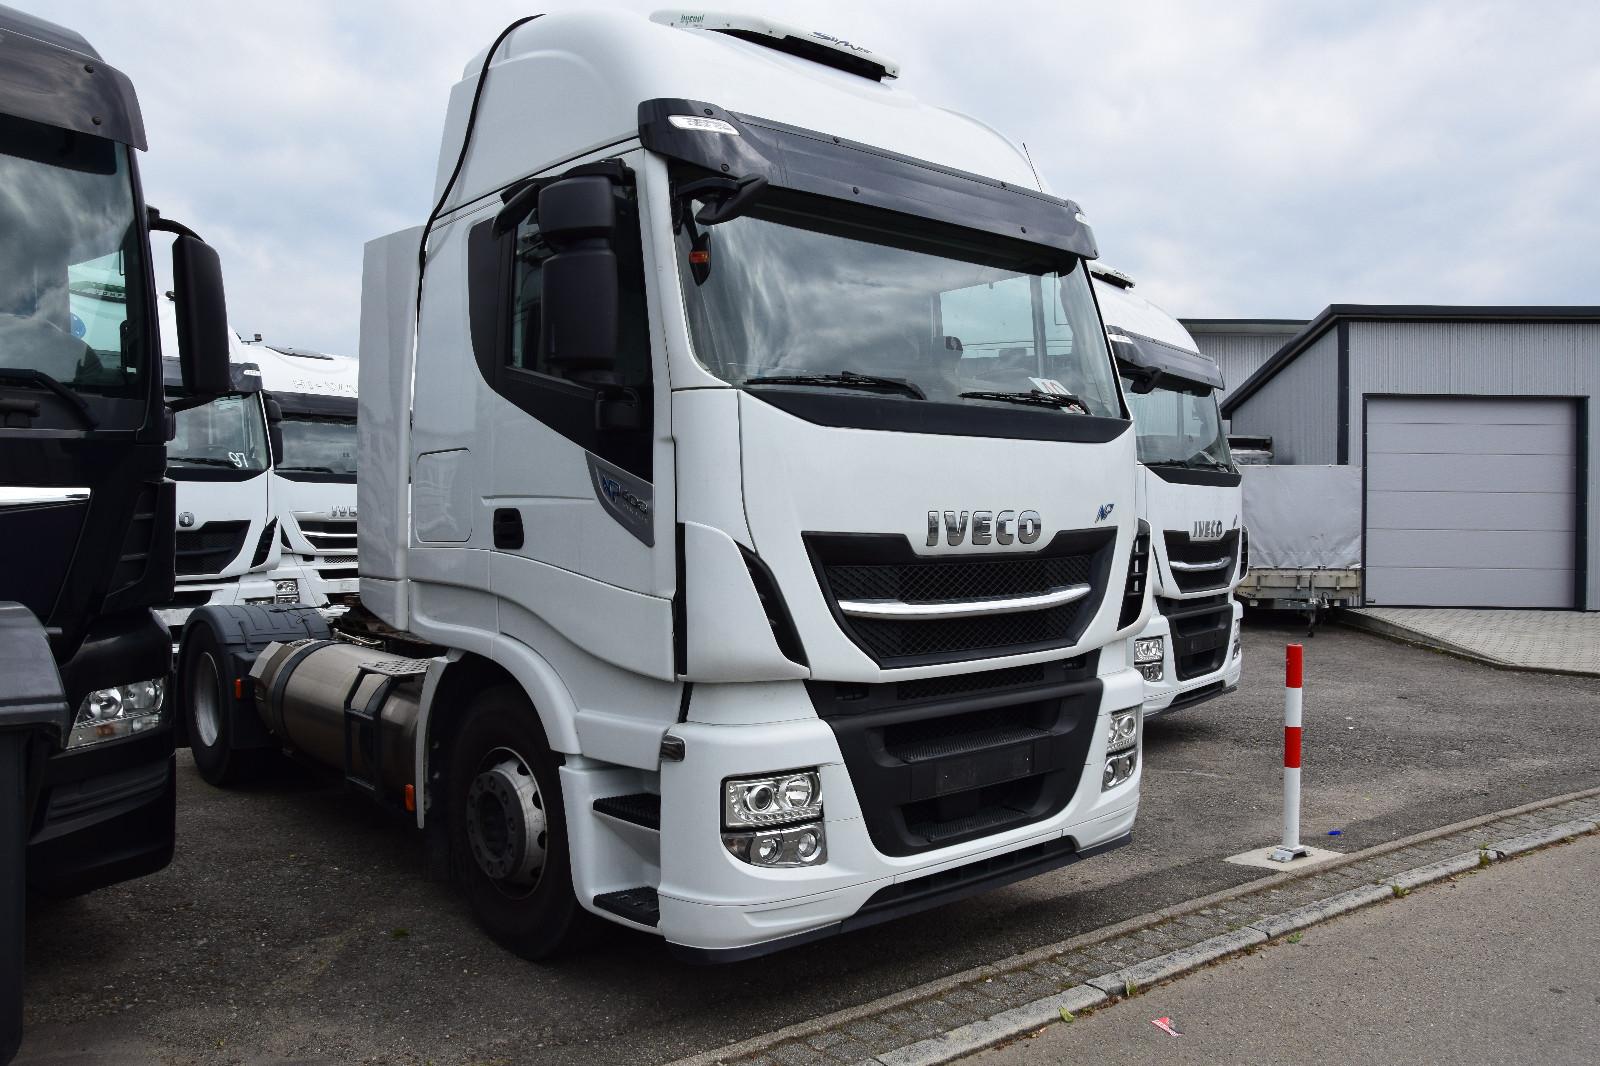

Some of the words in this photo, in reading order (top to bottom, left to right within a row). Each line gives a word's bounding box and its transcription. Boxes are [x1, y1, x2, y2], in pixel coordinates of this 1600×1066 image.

[228, 451, 249, 468] 97
[926, 509, 1042, 547] IVECO
[1192, 519, 1223, 538] IVECO
